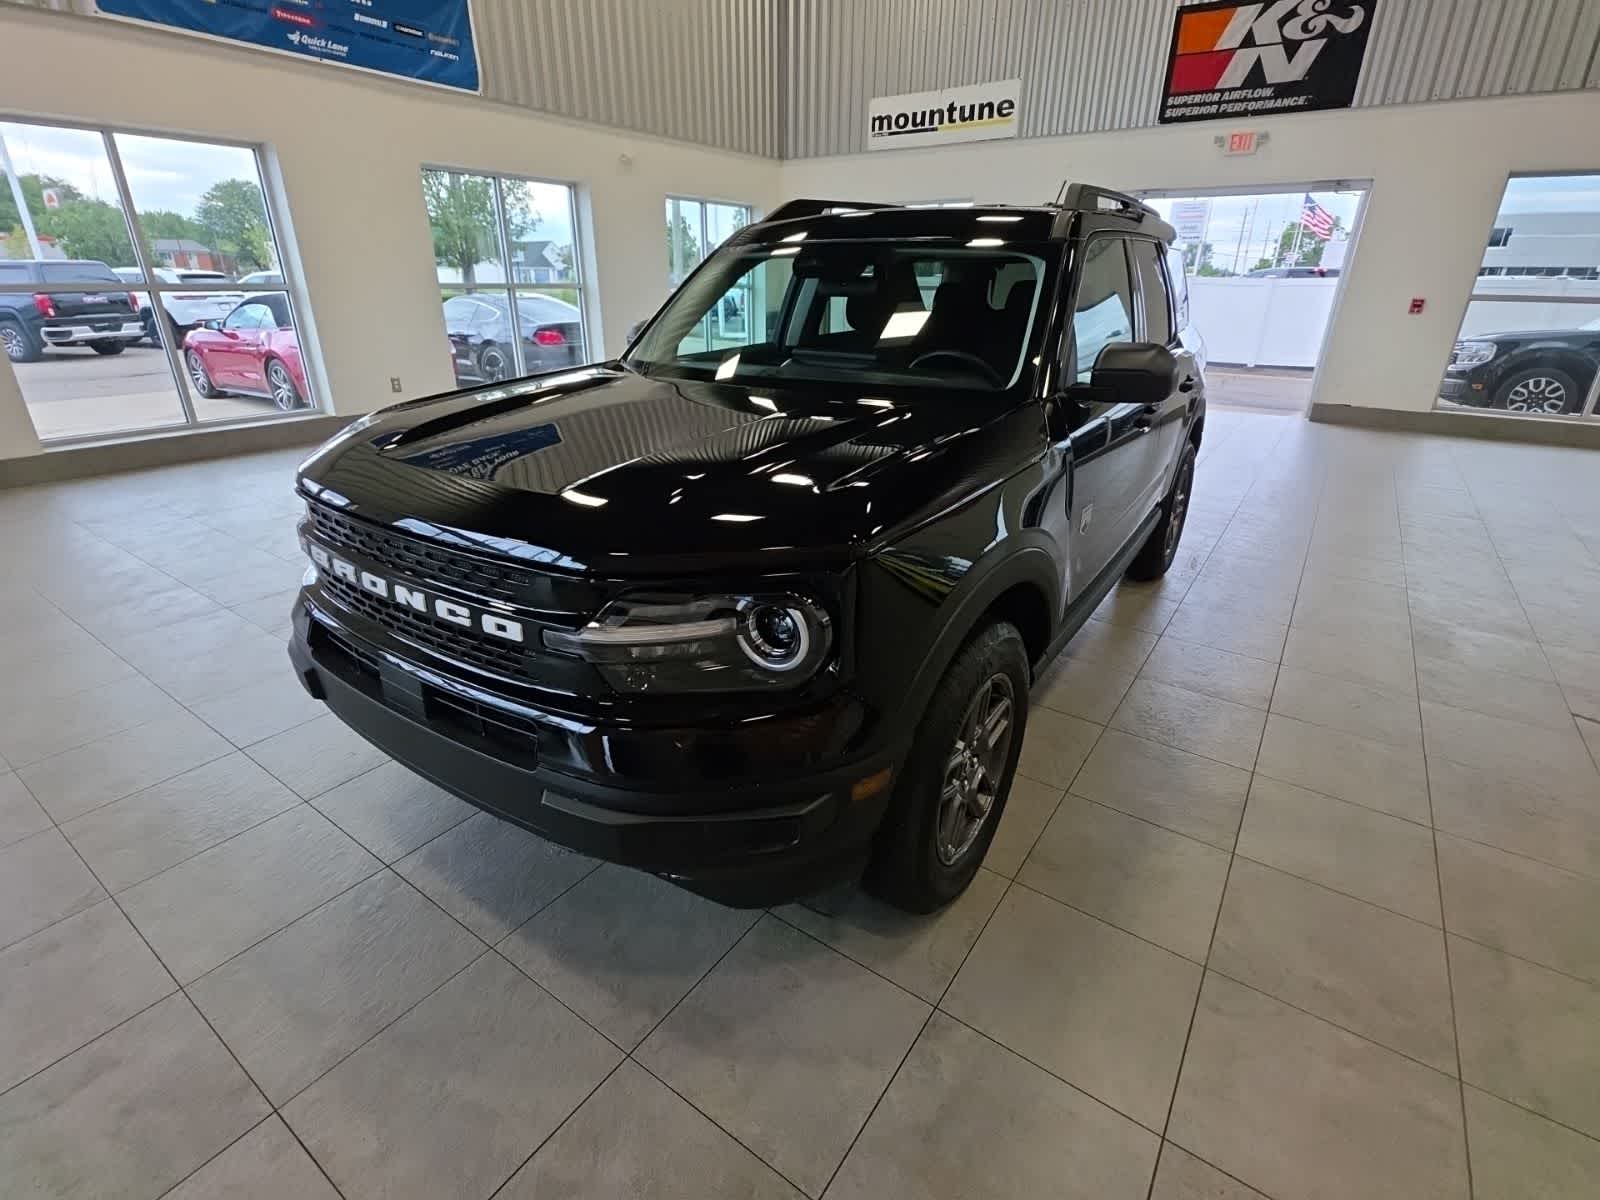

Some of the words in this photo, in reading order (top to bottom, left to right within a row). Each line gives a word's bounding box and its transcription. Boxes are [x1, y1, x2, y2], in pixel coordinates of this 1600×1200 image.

[301, 34, 327, 48] Quick
[327, 40, 349, 53] Lane
[1214, 0, 1364, 89] K&N
[1166, 92, 1221, 106] SUPERIOR
[1222, 87, 1275, 102] AIRFLOW.
[871, 98, 1015, 133] mountune
[1164, 103, 1218, 118] SUPERIOR
[1230, 133, 1254, 152] EXIT
[310, 543, 524, 642] BRONCO
